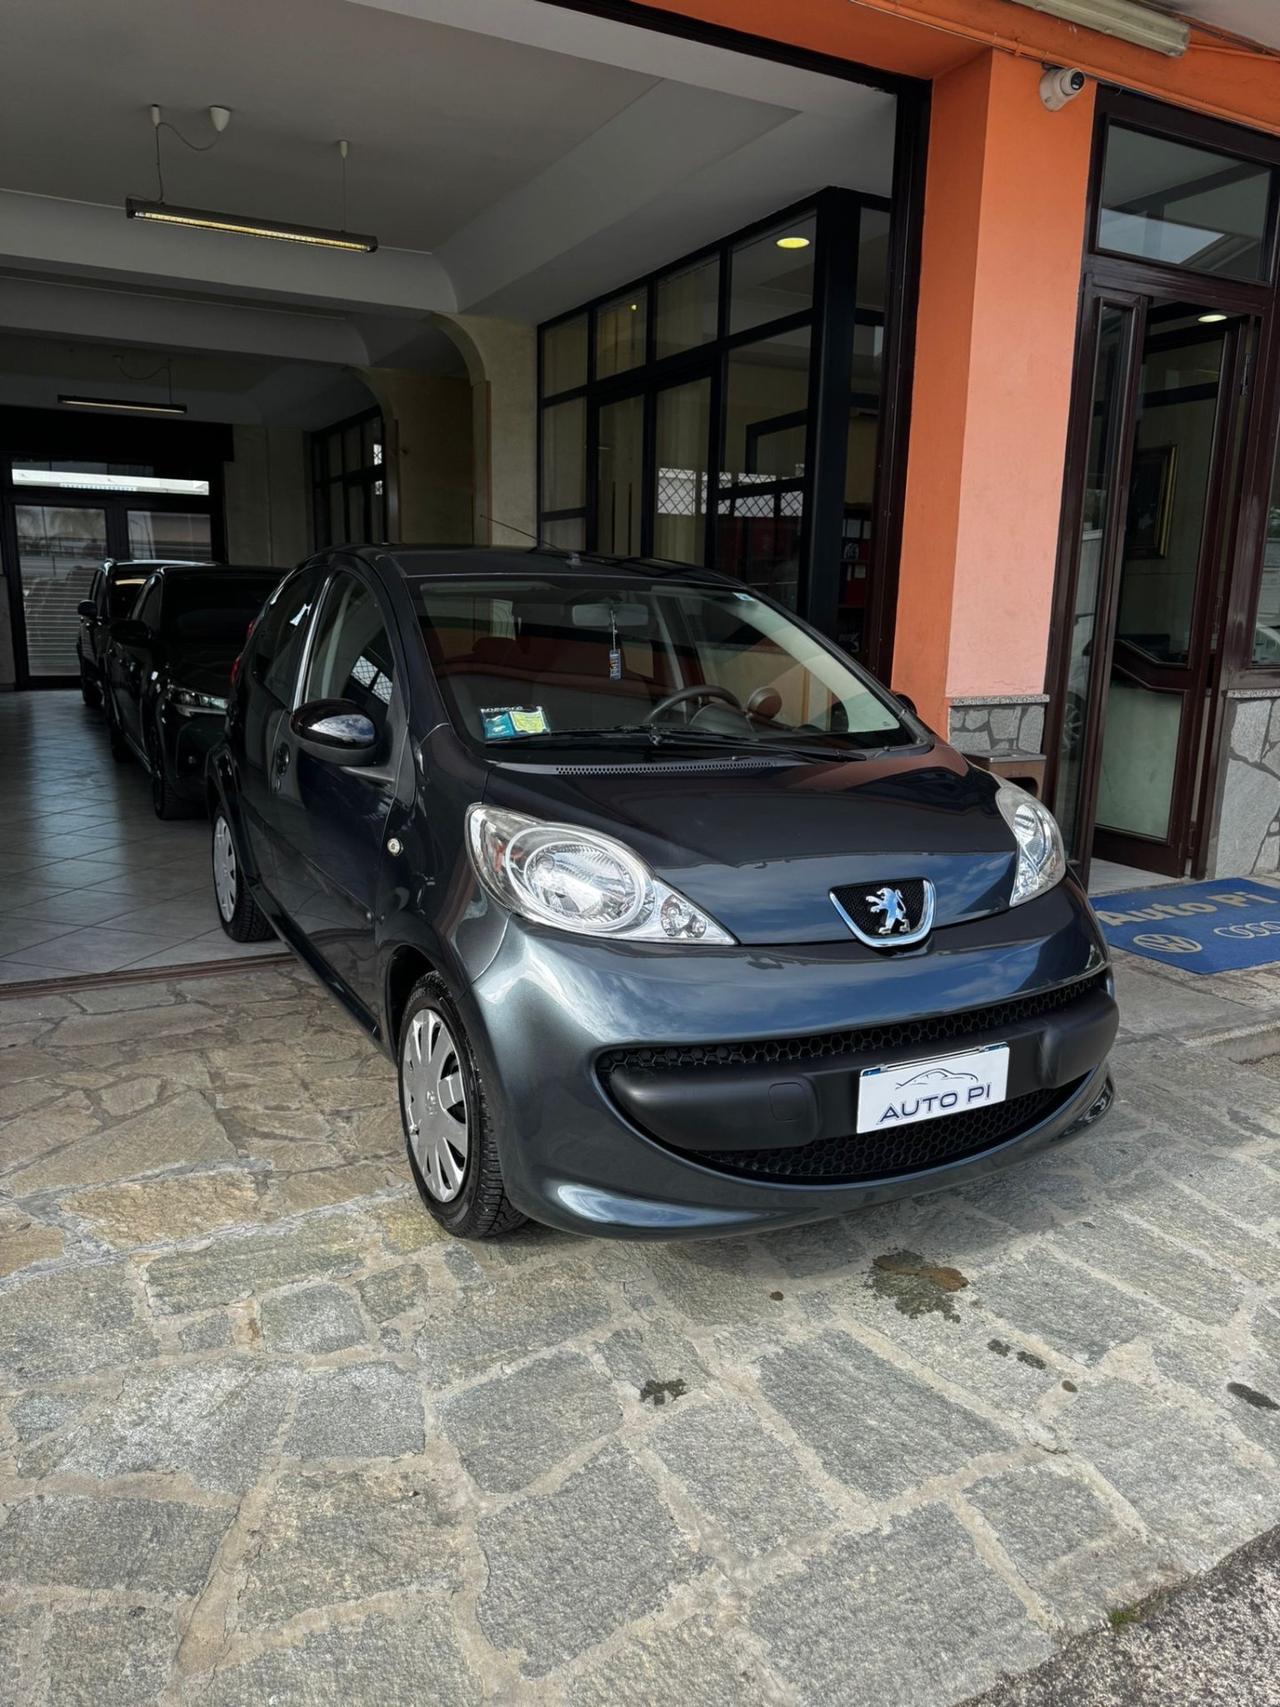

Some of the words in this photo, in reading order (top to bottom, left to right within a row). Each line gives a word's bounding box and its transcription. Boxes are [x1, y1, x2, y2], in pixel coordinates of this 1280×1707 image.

[1094, 902, 1218, 926] Auto
[1206, 891, 1278, 907] Pi
[879, 1092, 958, 1123] AUTO
[967, 1084, 991, 1103] PI
